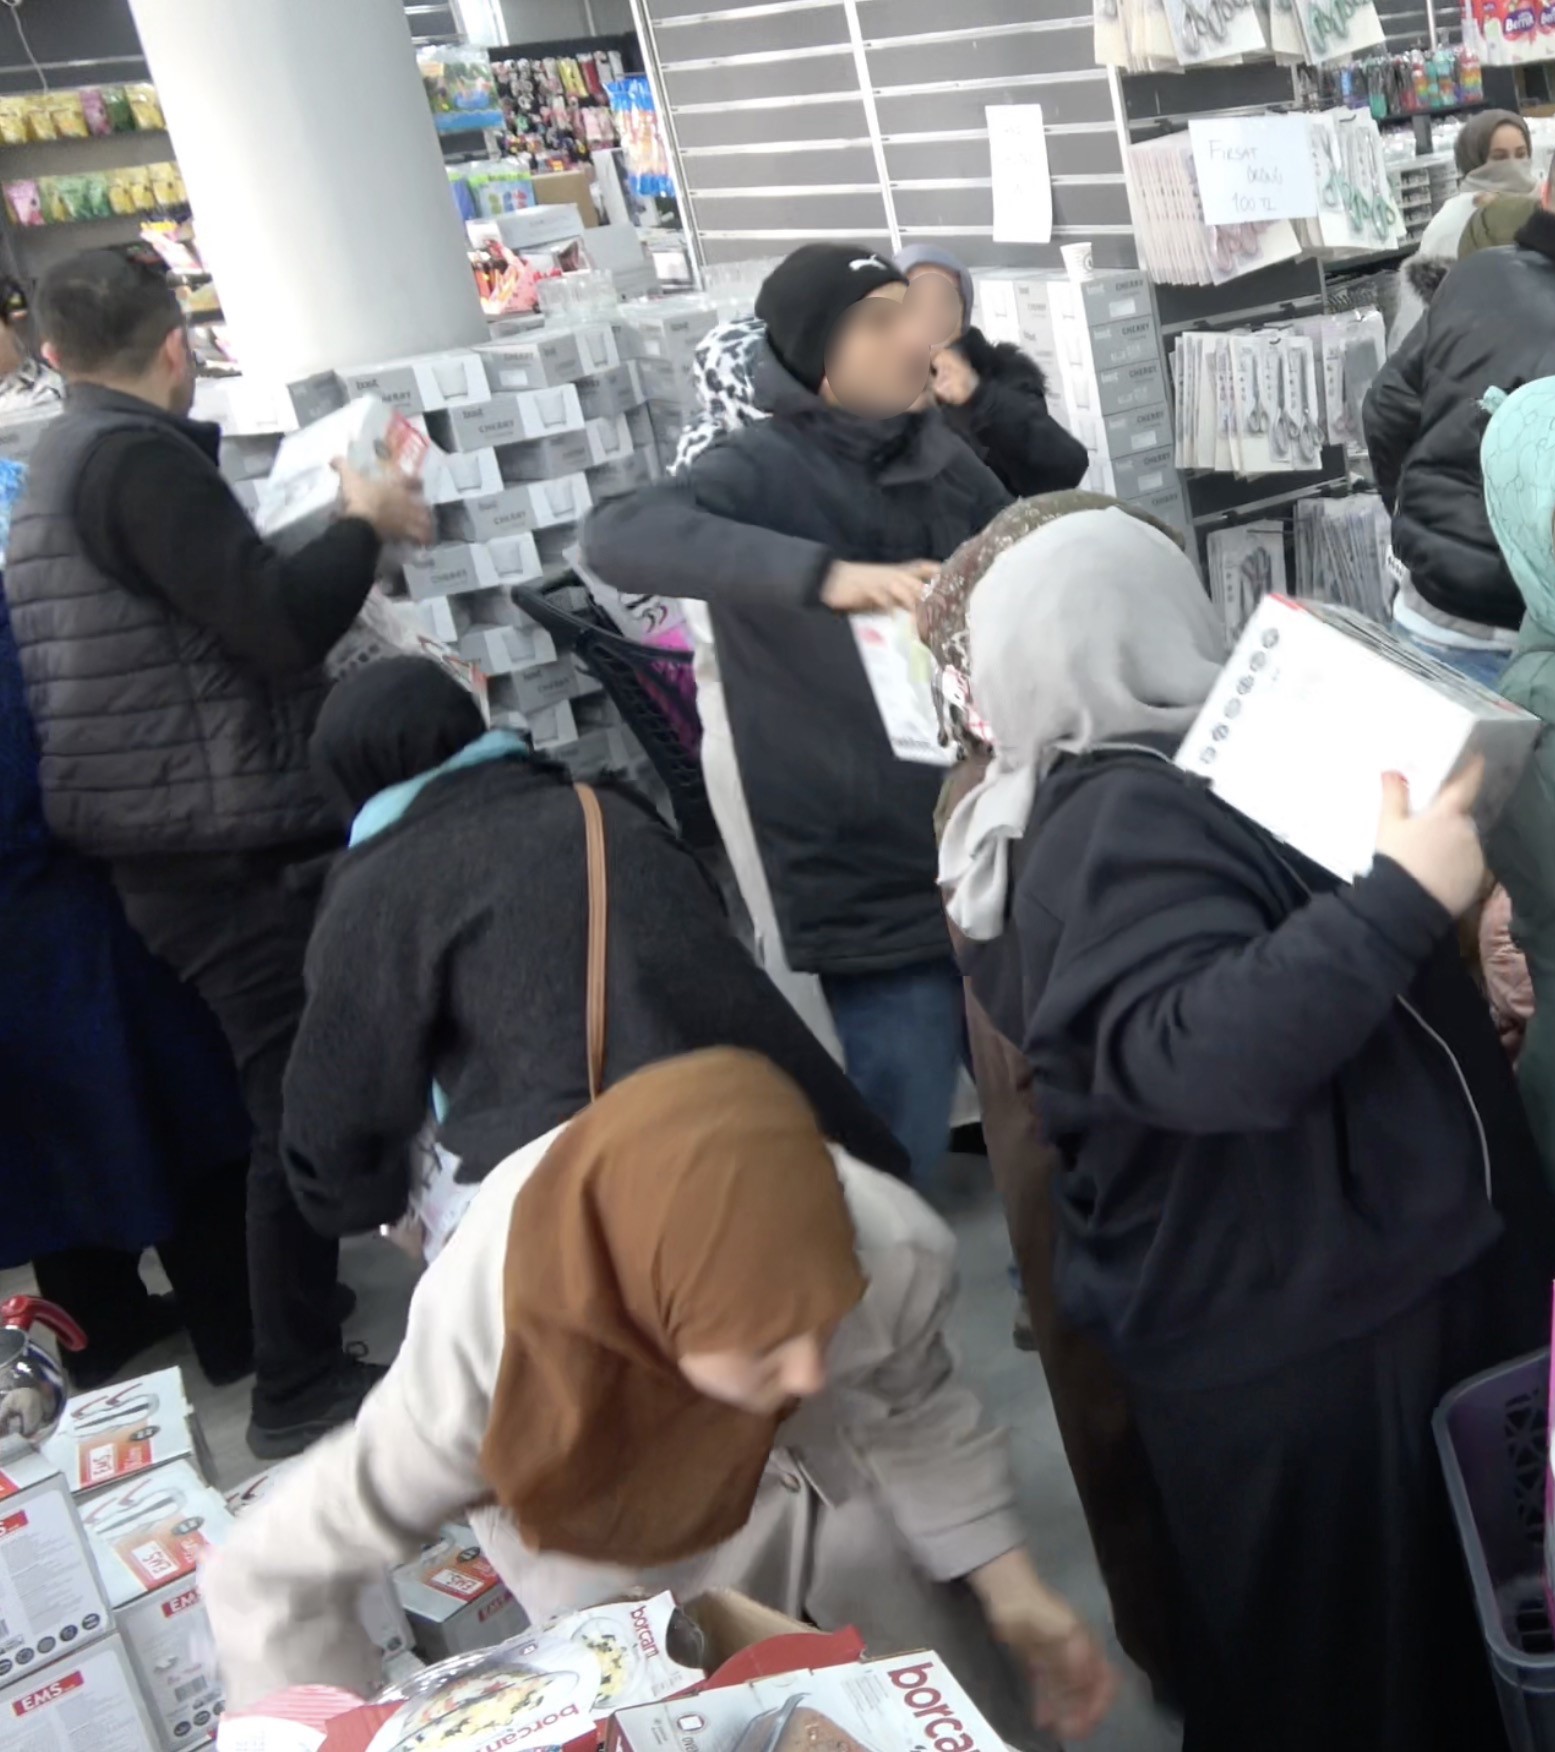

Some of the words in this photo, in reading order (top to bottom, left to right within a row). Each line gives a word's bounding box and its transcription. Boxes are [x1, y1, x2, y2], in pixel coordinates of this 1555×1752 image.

[169, 1591, 200, 1613] EM
[23, 1682, 63, 1711] EMS
[887, 1661, 980, 1752] borca
